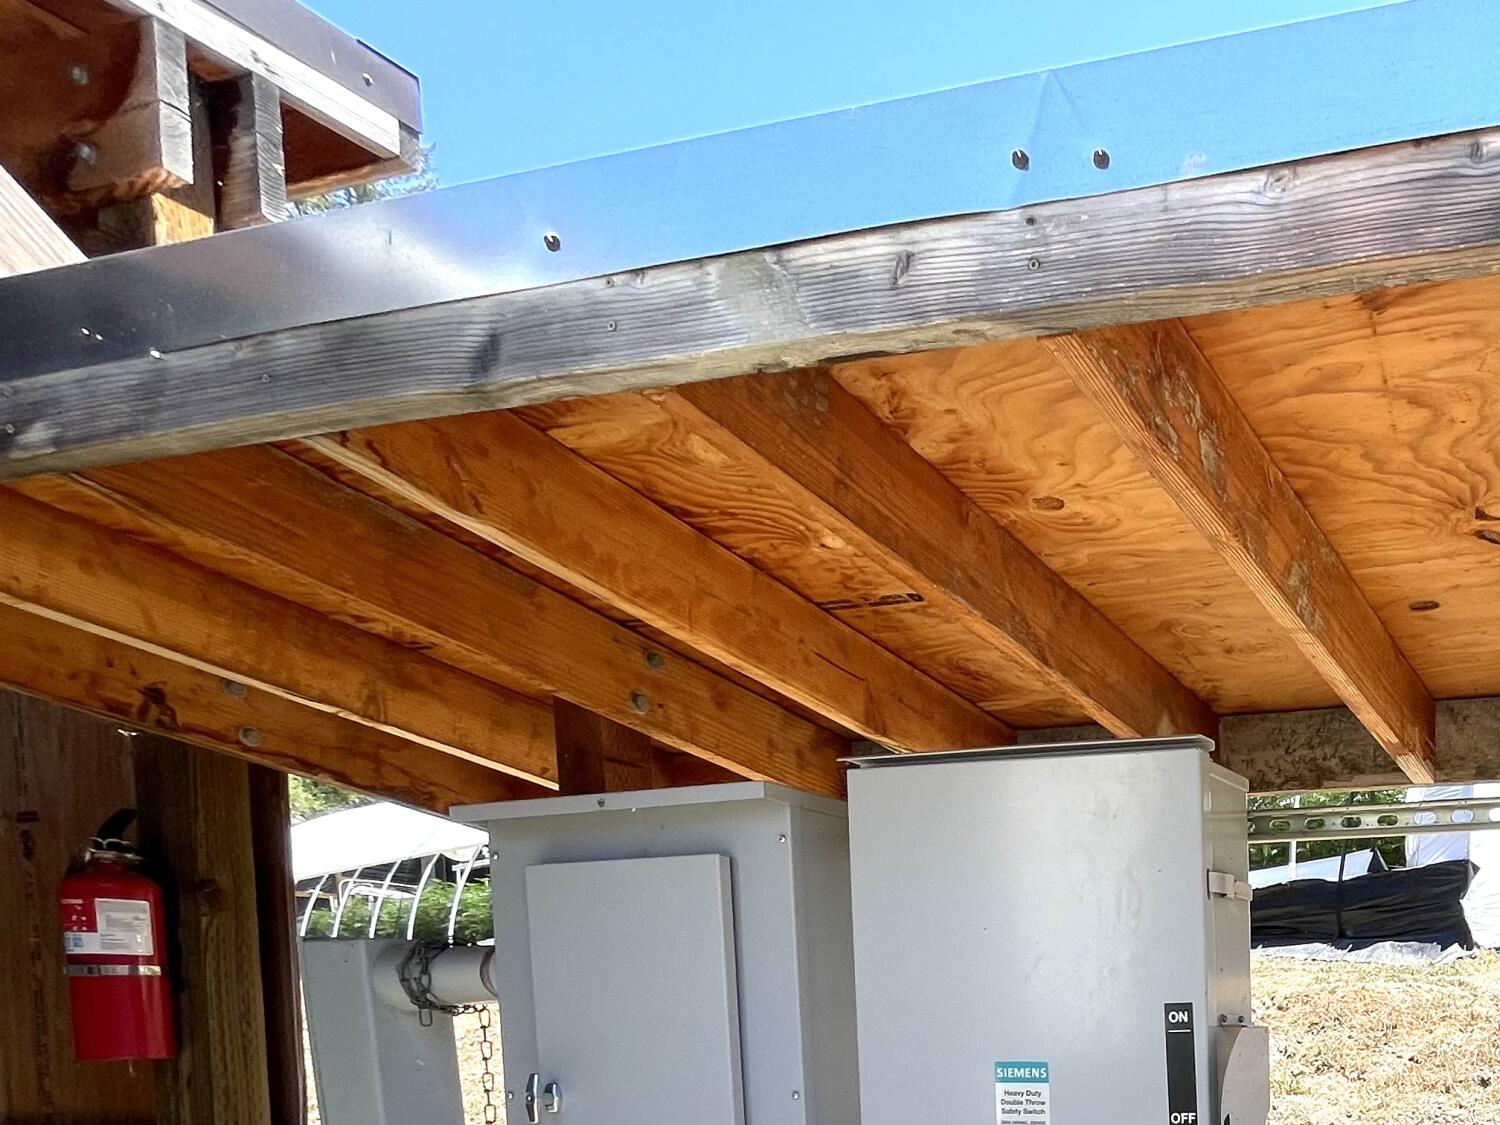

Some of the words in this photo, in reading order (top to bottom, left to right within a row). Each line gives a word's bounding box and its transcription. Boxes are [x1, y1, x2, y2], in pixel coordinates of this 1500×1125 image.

[1168, 1011, 1188, 1023] ON
[997, 1067, 1047, 1079] SIEMENS
[1004, 1089, 1024, 1097] Heavy
[1025, 1089, 1042, 1097] Duty
[1000, 1098, 1023, 1106] Double
[1025, 1098, 1046, 1106] Throw
[1001, 1107, 1022, 1116] Safety
[1023, 1107, 1046, 1115] Switch
[1171, 1112, 1196, 1124] OFF
